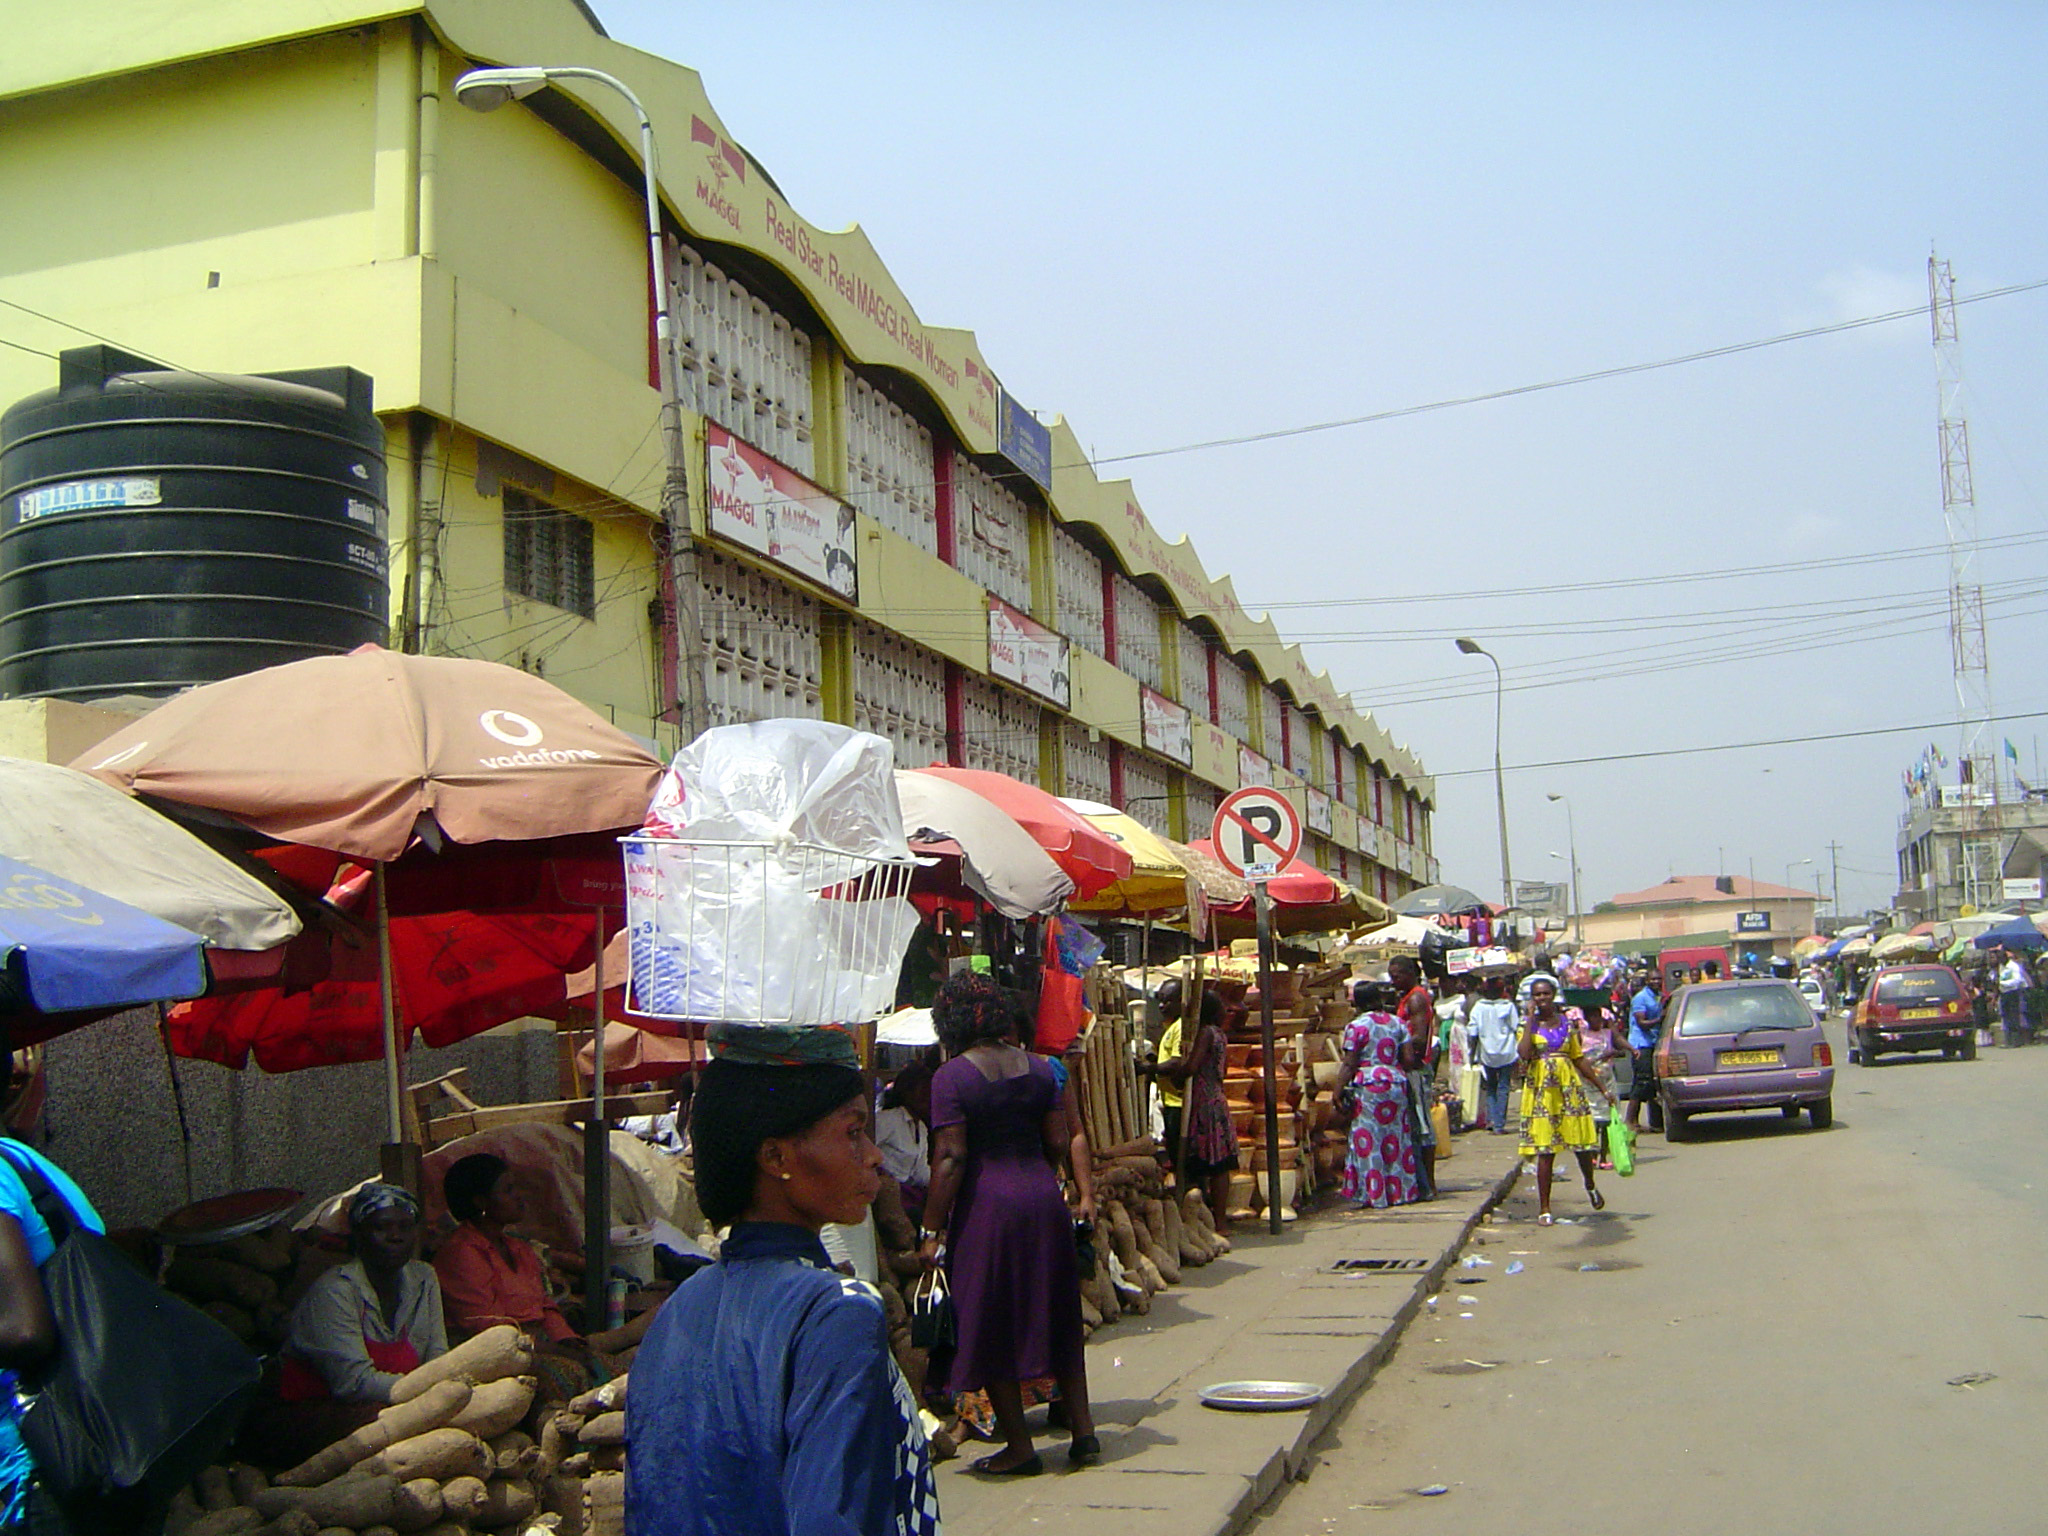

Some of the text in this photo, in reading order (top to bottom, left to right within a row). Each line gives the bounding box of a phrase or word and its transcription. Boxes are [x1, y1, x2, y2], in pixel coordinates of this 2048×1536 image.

[696, 178, 741, 231] MAGGI
[766, 197, 796, 256] Real
[828, 251, 855, 305] Real
[901, 315, 923, 361] Real
[924, 336, 959, 391] Woman
[712, 484, 756, 528] MAGGI
[479, 747, 602, 769] vodafone
[1210, 967, 1251, 980] MAGI
